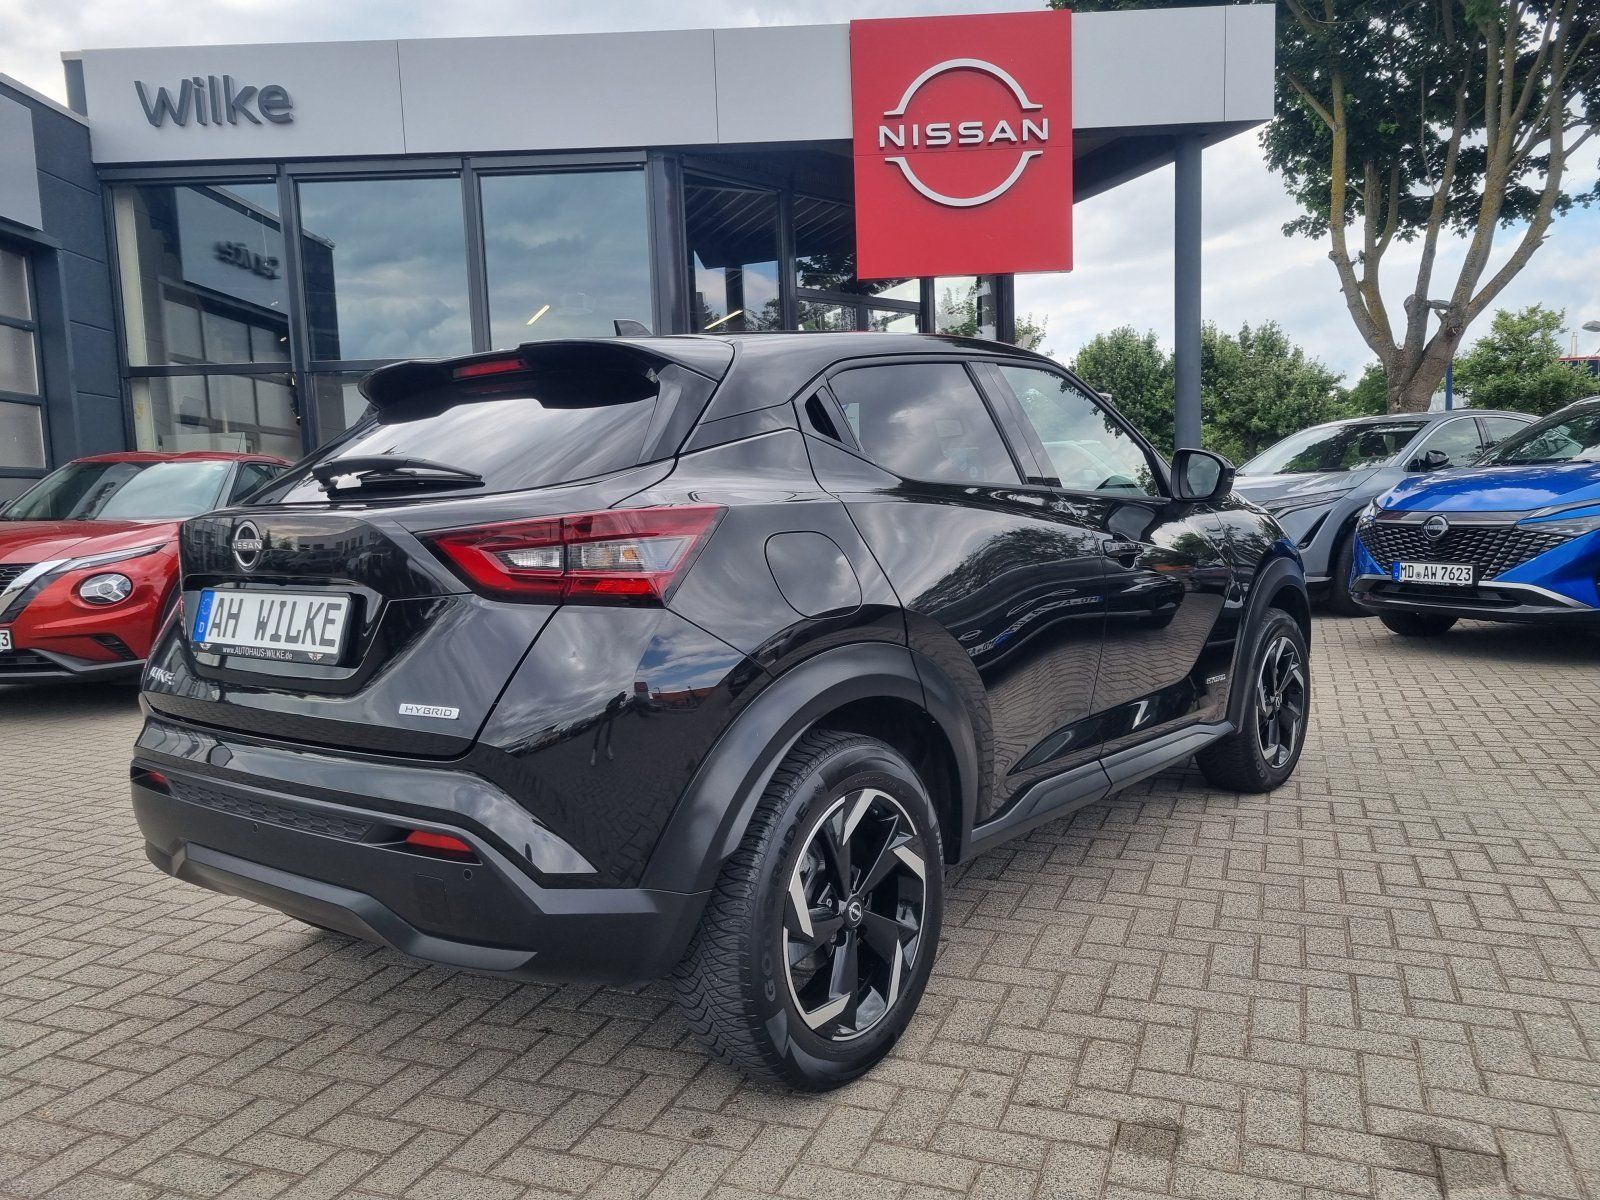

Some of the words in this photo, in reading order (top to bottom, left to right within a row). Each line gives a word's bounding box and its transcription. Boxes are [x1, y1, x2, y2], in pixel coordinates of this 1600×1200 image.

[134, 75, 294, 128] Wilke
[879, 118, 1049, 149] NISSAN
[1400, 564, 1414, 578] MD
[1423, 566, 1438, 580] AW
[1441, 566, 1472, 582] 7623
[208, 597, 244, 639] AH
[254, 599, 342, 648] WILKE
[147, 666, 176, 686] JUKE
[404, 705, 453, 717] HYBRID
